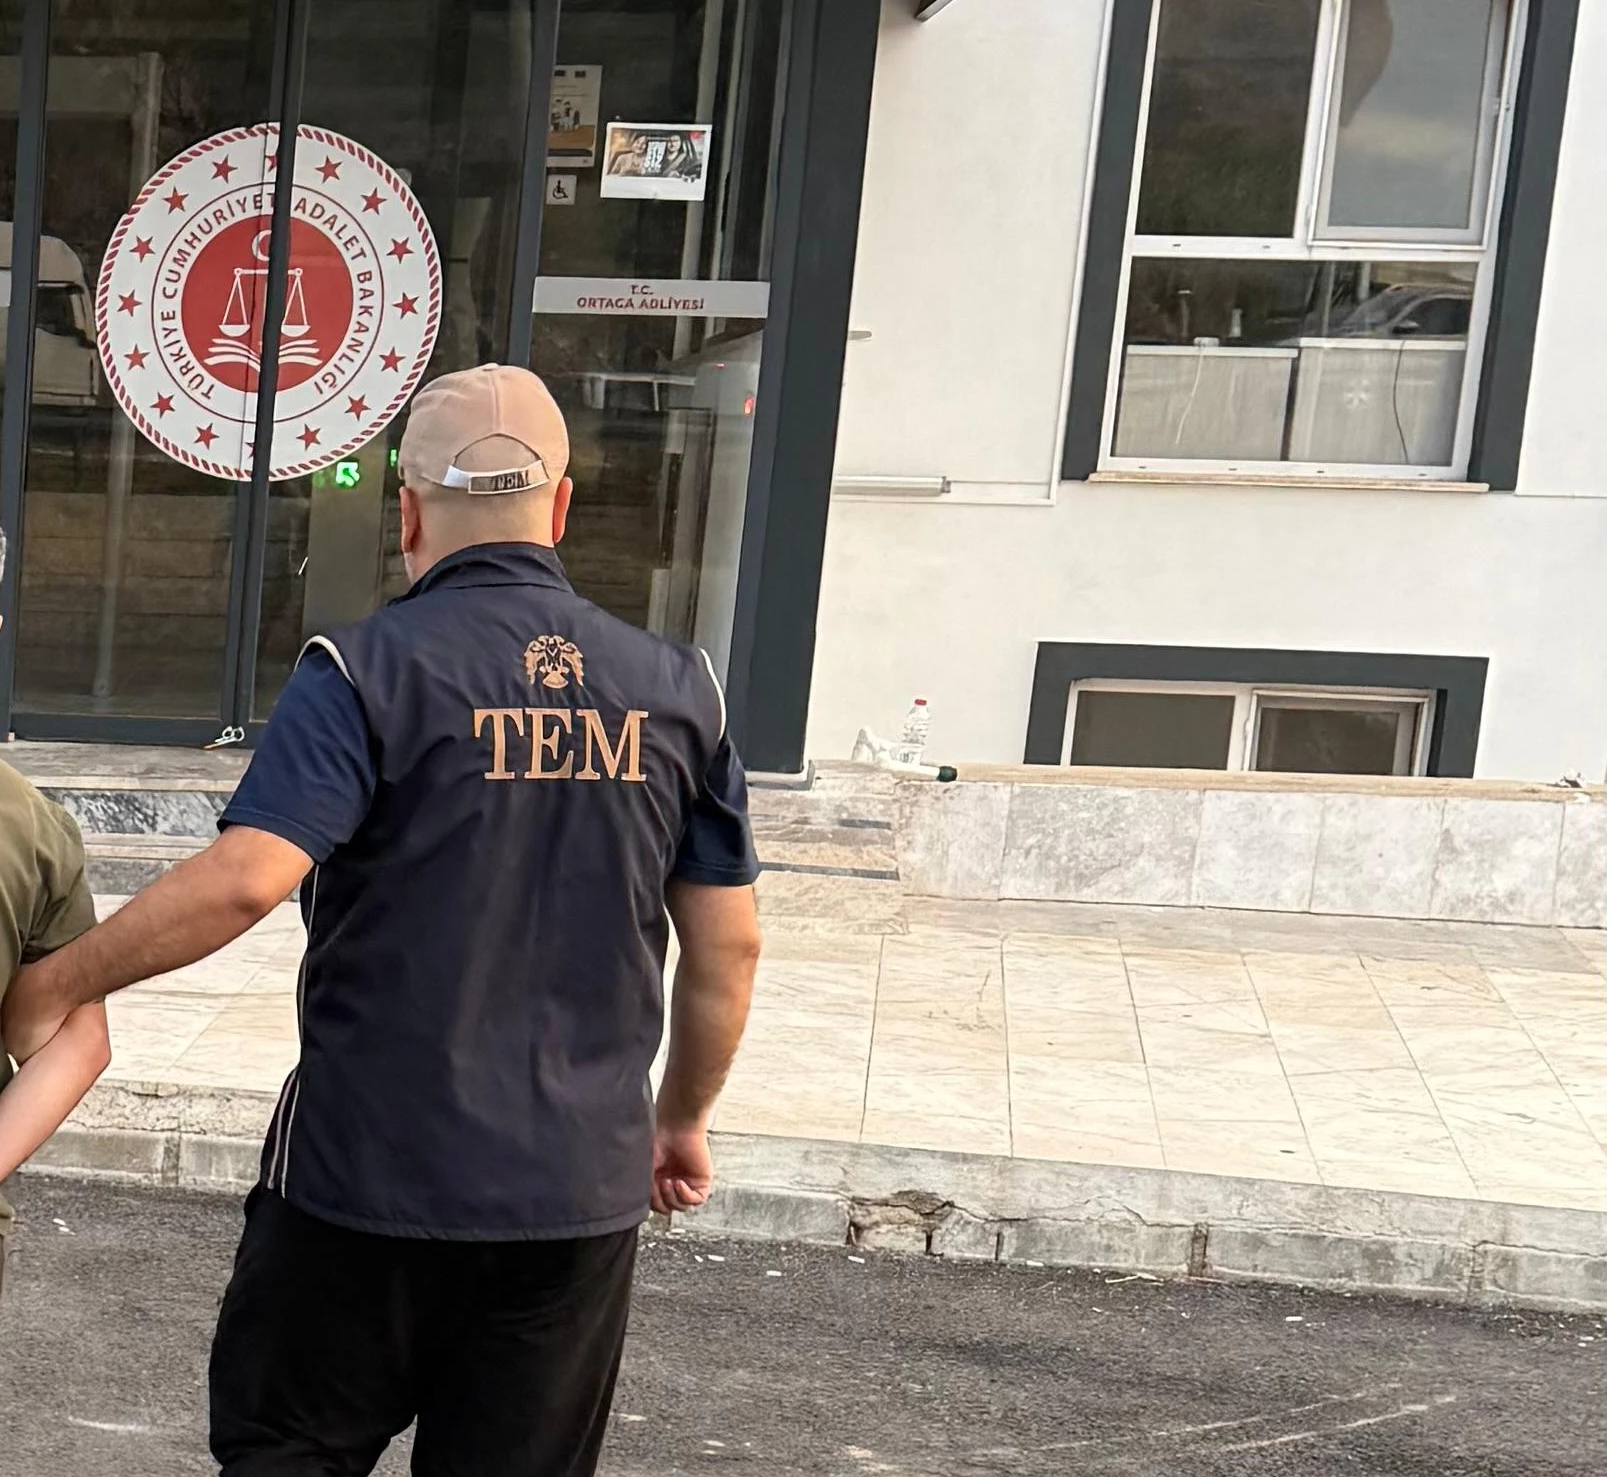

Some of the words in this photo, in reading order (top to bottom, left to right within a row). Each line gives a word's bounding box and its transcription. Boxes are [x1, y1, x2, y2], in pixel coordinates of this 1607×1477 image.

[162, 192, 276, 300] CUMHURİYET
[294, 197, 367, 262] ADALET
[161, 309, 216, 401] TÜRKİYE
[312, 270, 375, 395] BAKANLIĞI
[474, 708, 649, 782] TEM
